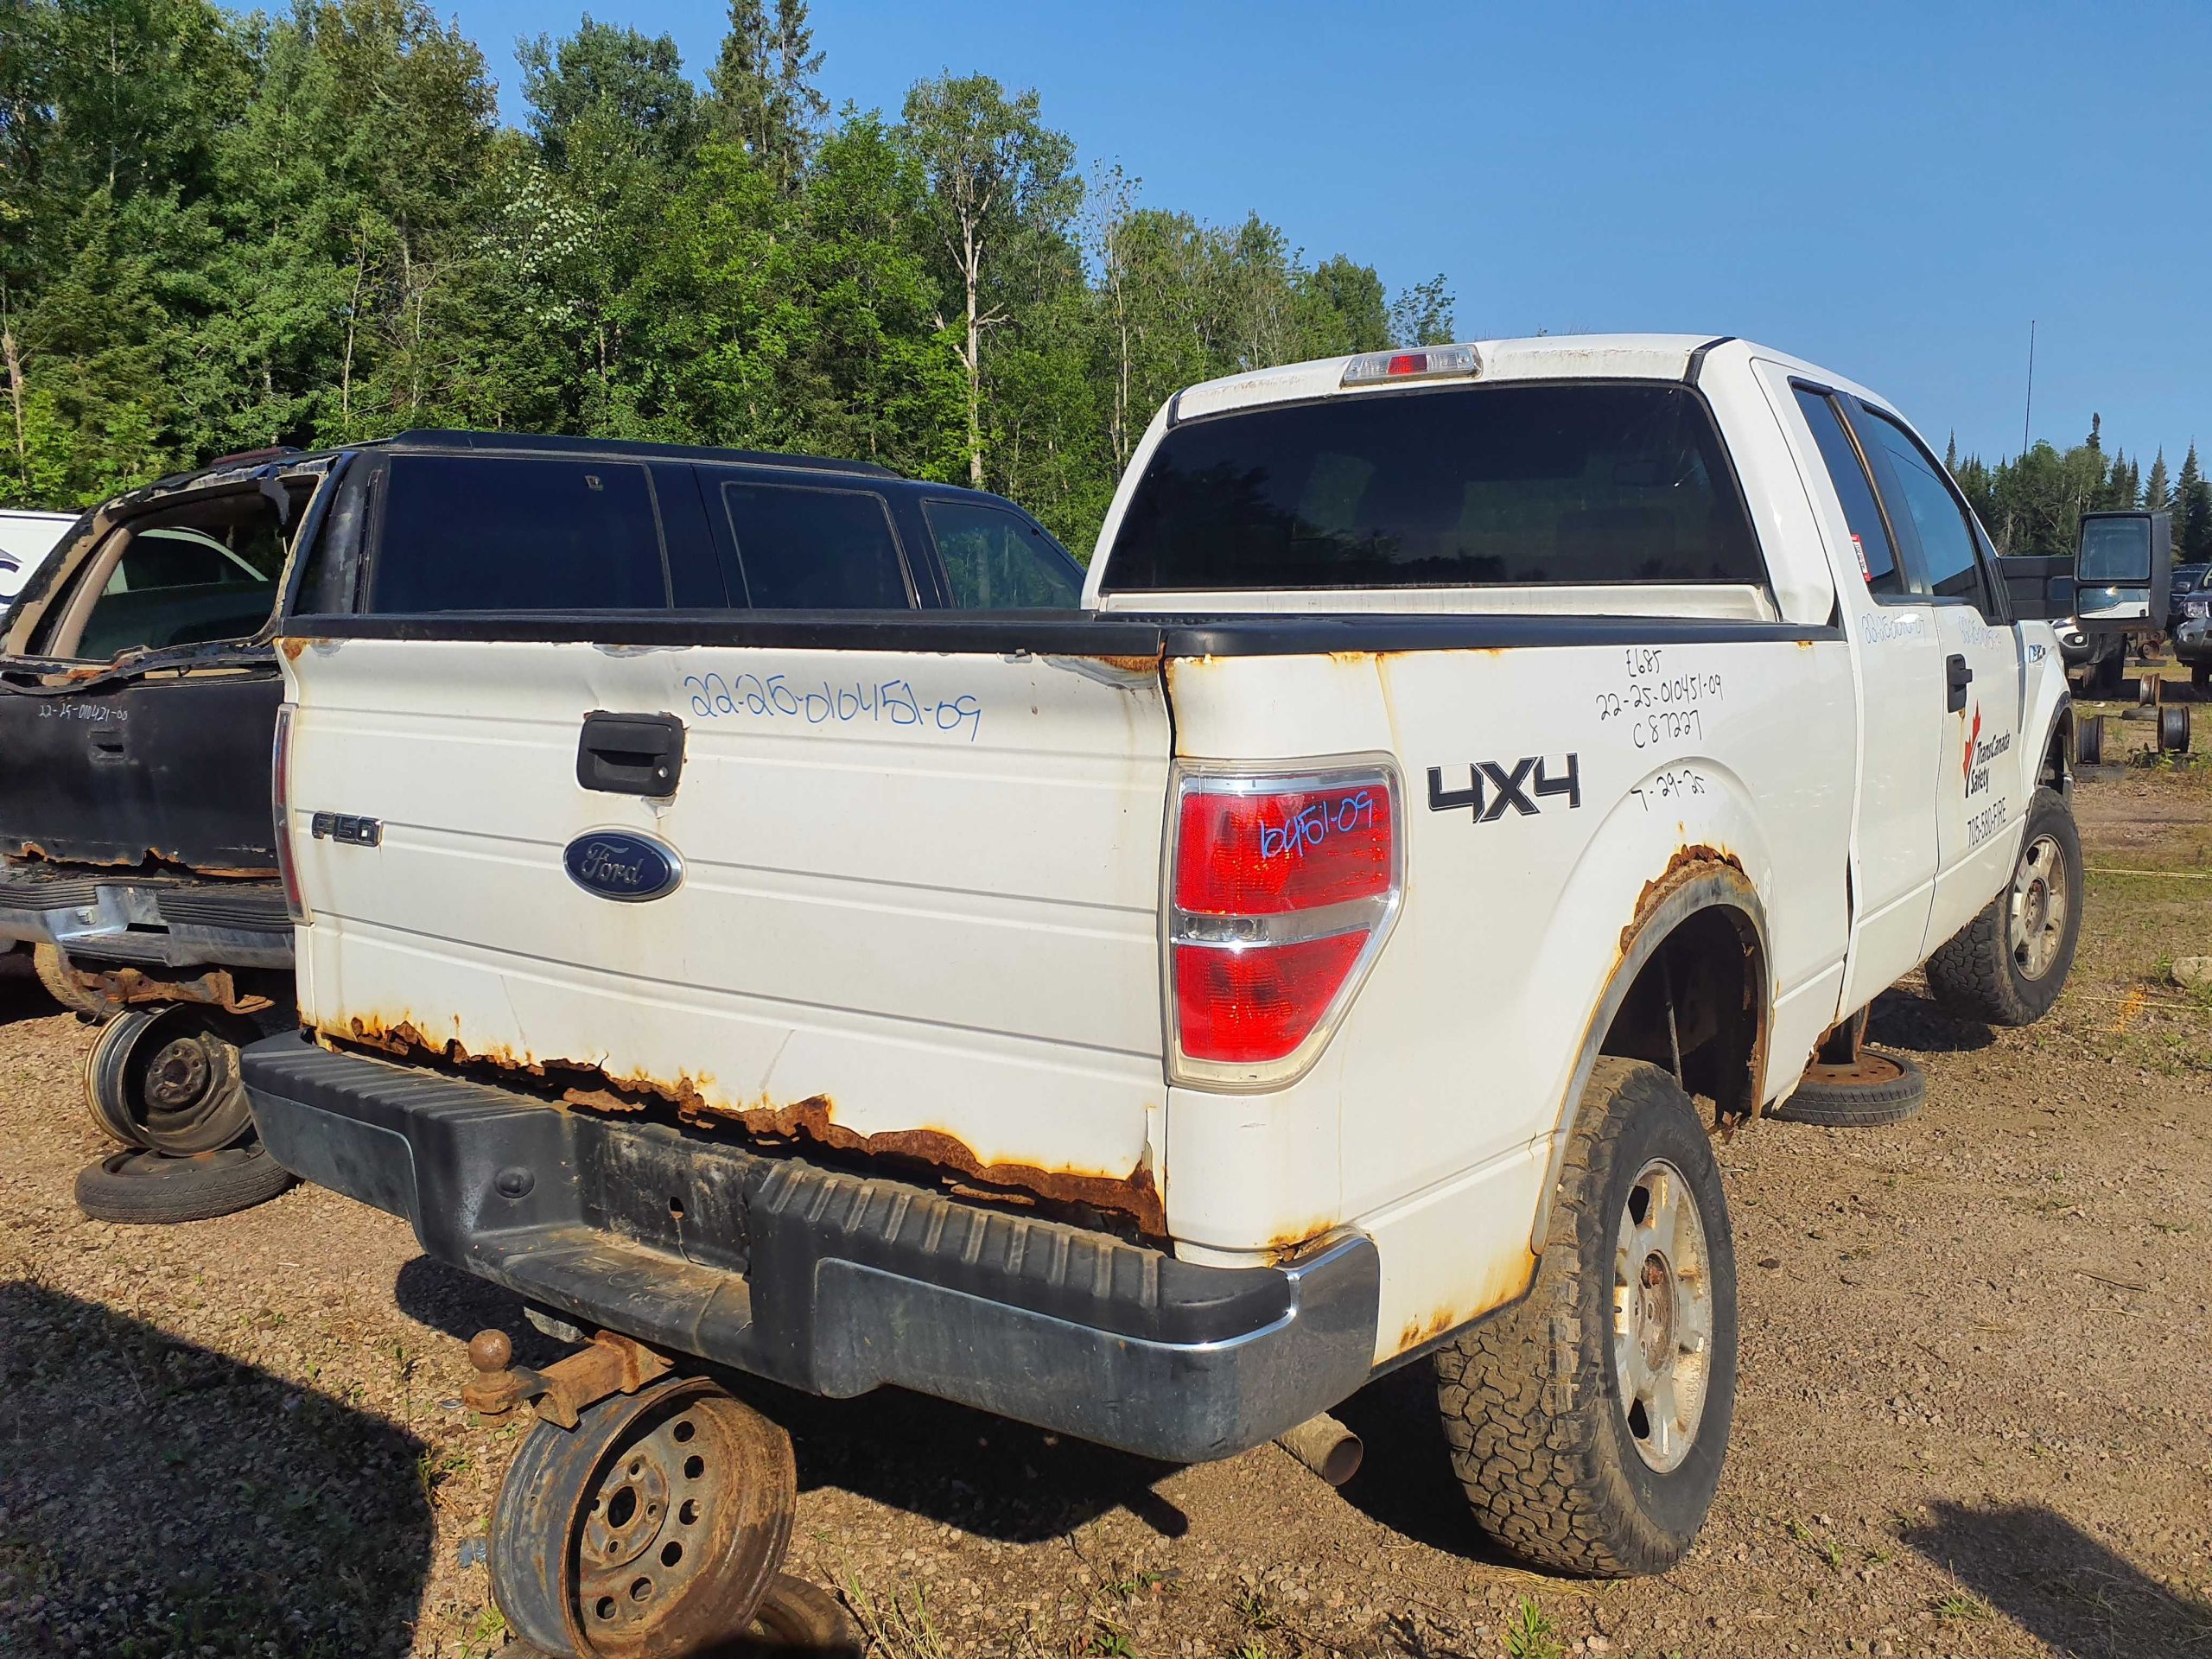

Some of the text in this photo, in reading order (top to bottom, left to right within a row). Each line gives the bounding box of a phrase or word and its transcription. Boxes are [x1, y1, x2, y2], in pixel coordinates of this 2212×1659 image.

[1975, 729, 2011, 766] TransCanada
[1970, 767, 1990, 794] Safety
[1967, 797, 2006, 849] 705-580-FIRE
[582, 842, 644, 886] Ford
